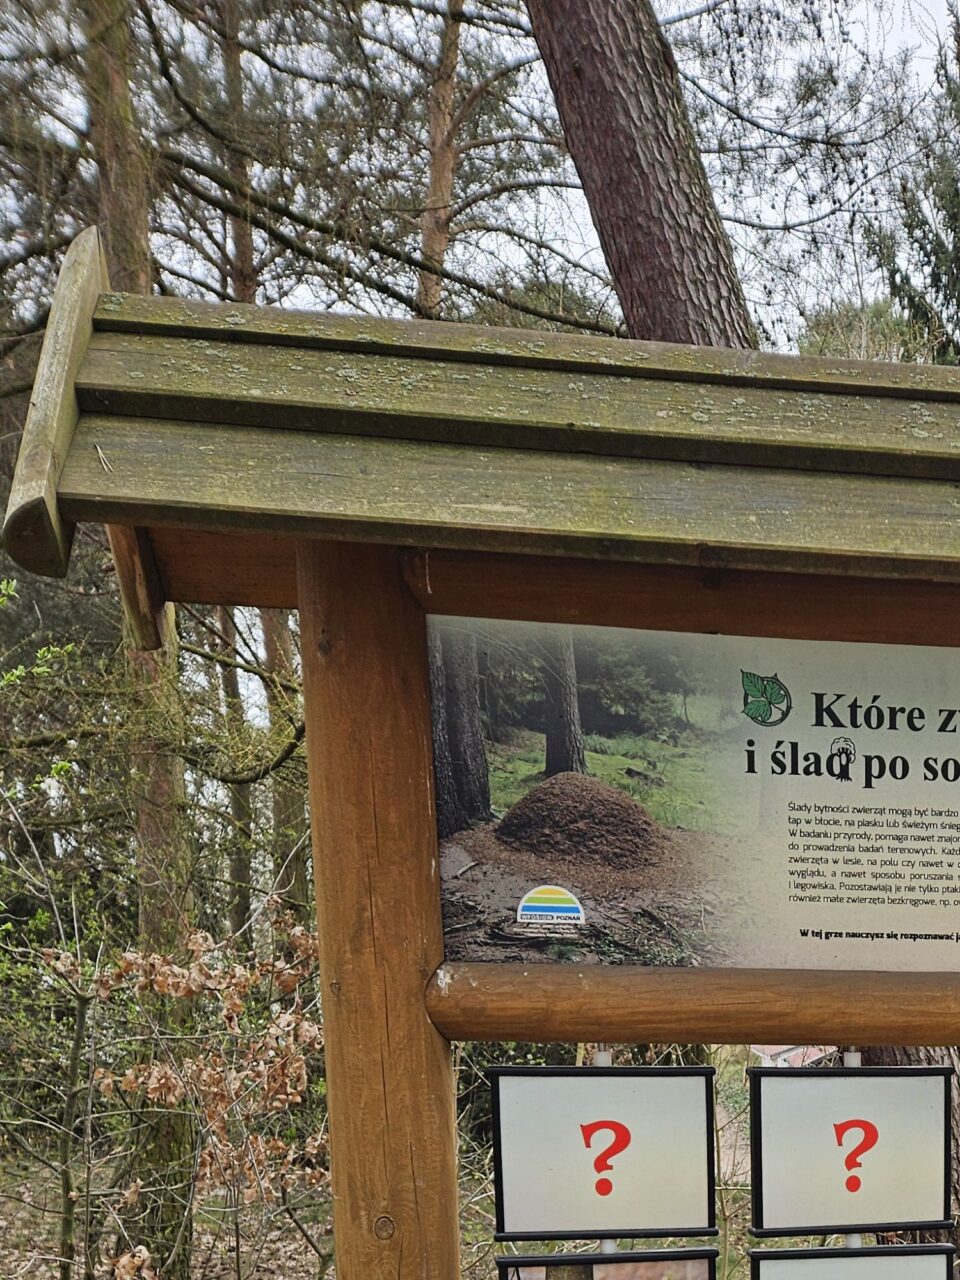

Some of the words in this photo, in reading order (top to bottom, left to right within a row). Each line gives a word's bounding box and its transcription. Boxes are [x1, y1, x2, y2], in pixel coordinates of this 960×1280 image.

[811, 691, 925, 731] Które
[745, 738, 757, 774] i
[770, 738, 853, 780] ślad
[862, 753, 910, 789] po
[787, 802, 812, 814] Ślady
[813, 803, 850, 815] bytności
[851, 806, 886, 816] zwierząt
[888, 808, 913, 818] mogą
[913, 806, 929, 818] być
[930, 807, 959, 817] bardzo
[814, 816, 842, 827] błocie,
[844, 819, 856, 828] na
[857, 818, 884, 829] piasku
[885, 818, 900, 828] lub
[901, 820, 938, 831] świeżym
[799, 828, 832, 839] badaniu
[833, 831, 874, 842] przyrody,
[874, 833, 909, 844] pomaga
[909, 834, 935, 842] nawet
[787, 841, 800, 851] do
[802, 843, 856, 853] prowadzenia
[858, 843, 884, 853] badań
[887, 845, 938, 856] terenowych.
[787, 855, 829, 865] zwierzęta
[842, 856, 864, 866] lesie,
[866, 858, 878, 866] na
[879, 857, 899, 868] polu
[901, 860, 916, 869] czy
[918, 860, 944, 868] nawet
[788, 868, 827, 879] wyglądu,
[840, 870, 867, 879] nawet
[870, 870, 906, 881] sposobu
[909, 872, 954, 882] poruszania
[793, 881, 837, 892] legowiska.
[894, 883, 902, 894] je
[903, 884, 916, 893] nie
[918, 884, 940, 895] tylko
[788, 893, 822, 903] również
[822, 894, 845, 903] małe
[845, 896, 886, 905] zwierzęta
[939, 899, 952, 908] np.
[810, 929, 823, 940] tej
[824, 931, 844, 940] grze
[845, 931, 885, 941] nauczysz
[885, 930, 899, 941] się
[582, 1121, 630, 1195] ?
[835, 1120, 878, 1192] ?
